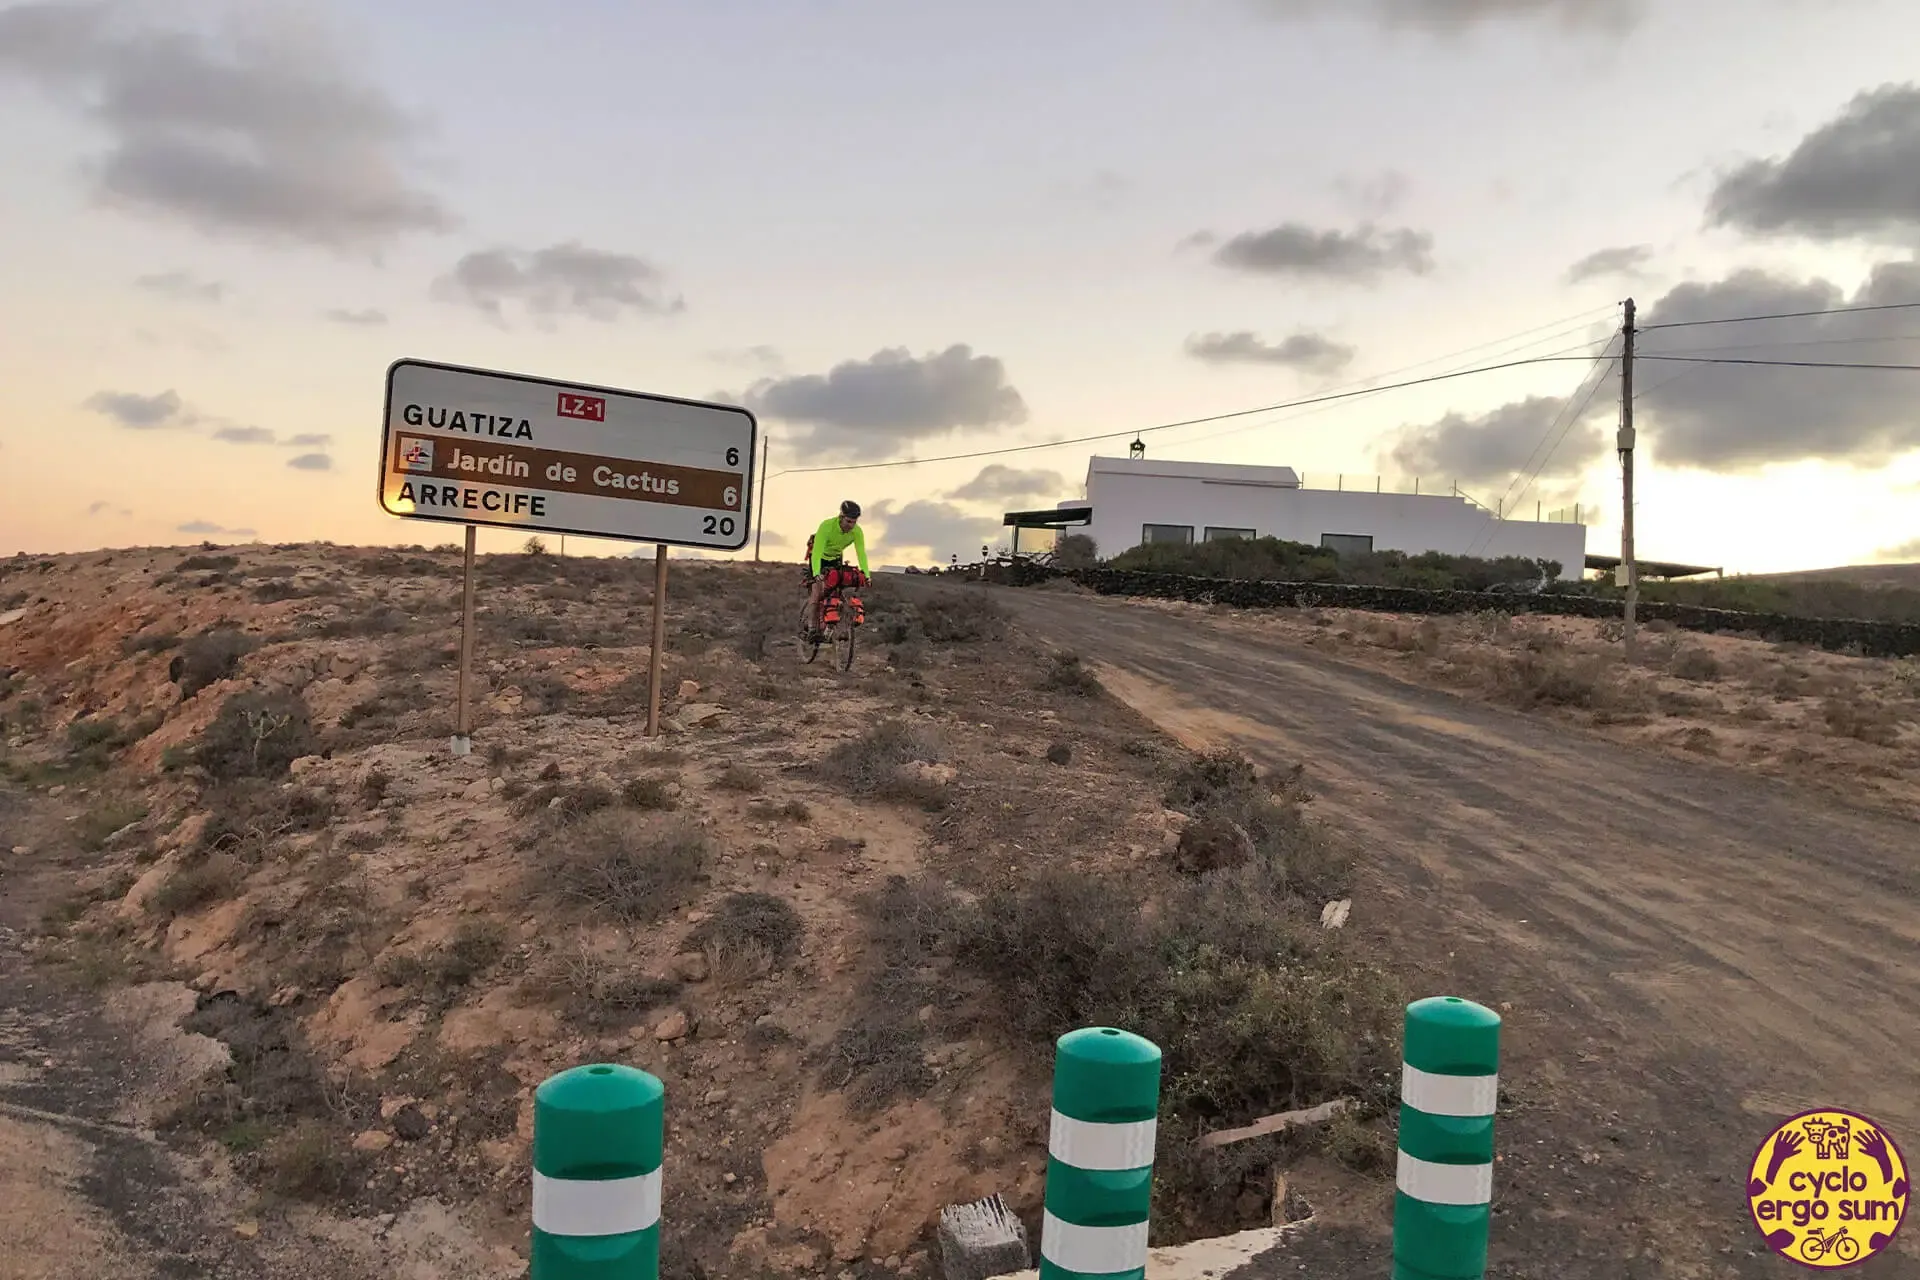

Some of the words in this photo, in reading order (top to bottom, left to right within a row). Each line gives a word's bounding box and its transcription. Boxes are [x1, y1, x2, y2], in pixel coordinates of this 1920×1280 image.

[403, 404, 534, 441] GUATIZA
[725, 447, 740, 467] 6
[559, 396, 604, 419] LZ-1
[447, 447, 530, 478] Jardín
[545, 462, 577, 483] de
[592, 466, 680, 495] Cactus
[722, 486, 738, 507] 6
[397, 482, 546, 517] ARRECIFE
[702, 515, 736, 537] 20
